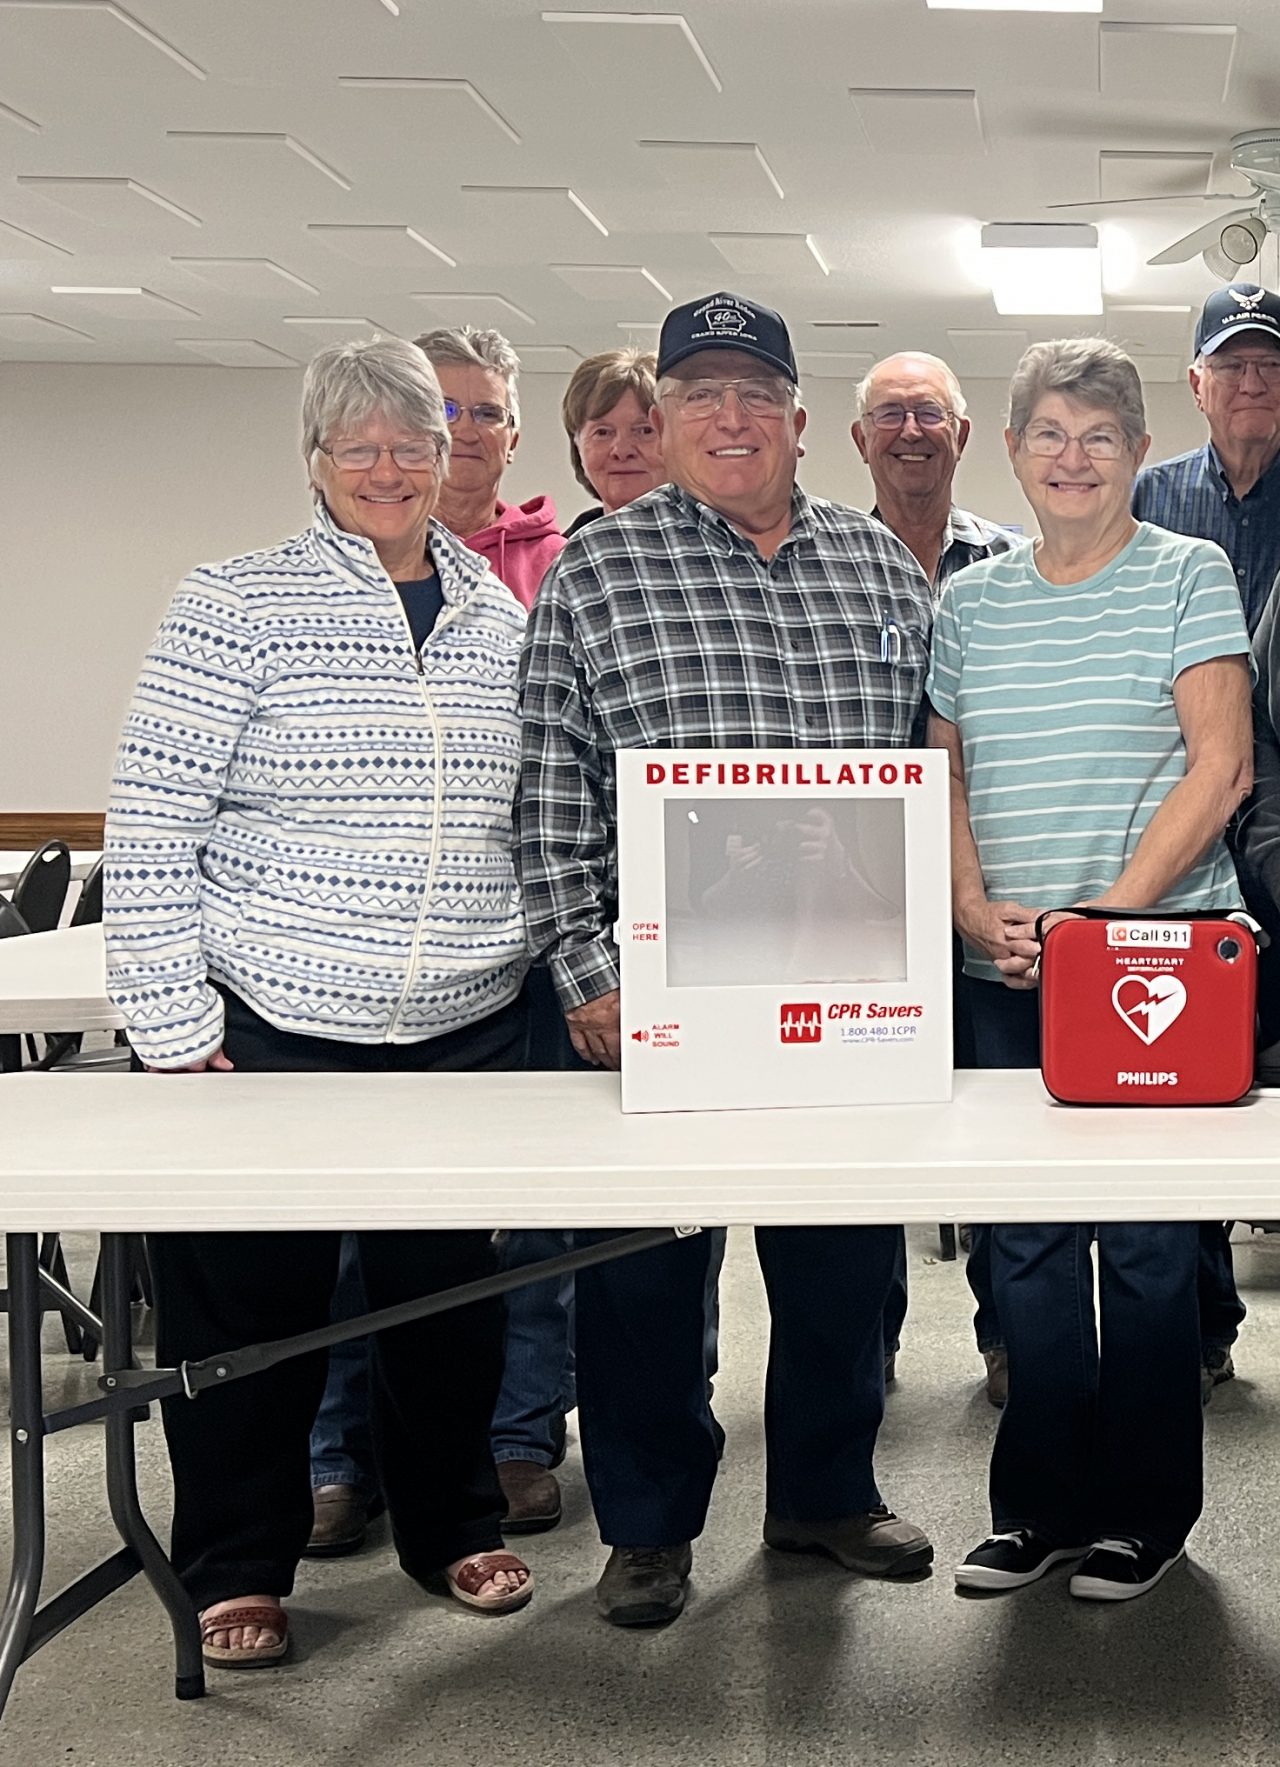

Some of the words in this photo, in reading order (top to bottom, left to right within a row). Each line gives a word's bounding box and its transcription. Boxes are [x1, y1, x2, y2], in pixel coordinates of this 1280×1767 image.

[646, 763, 924, 785] DEFIBRILLATOR
[632, 923, 659, 931] OPEN
[632, 933, 659, 941] HERE
[1130, 929, 1159, 942] Call
[1163, 930, 1187, 943] 911
[1115, 957, 1184, 966] HEARTSTART
[827, 1003, 862, 1019] CPR
[866, 1003, 923, 1019] Savers
[654, 1032, 673, 1040] WILL
[1117, 1072, 1179, 1085] PHILIPS
